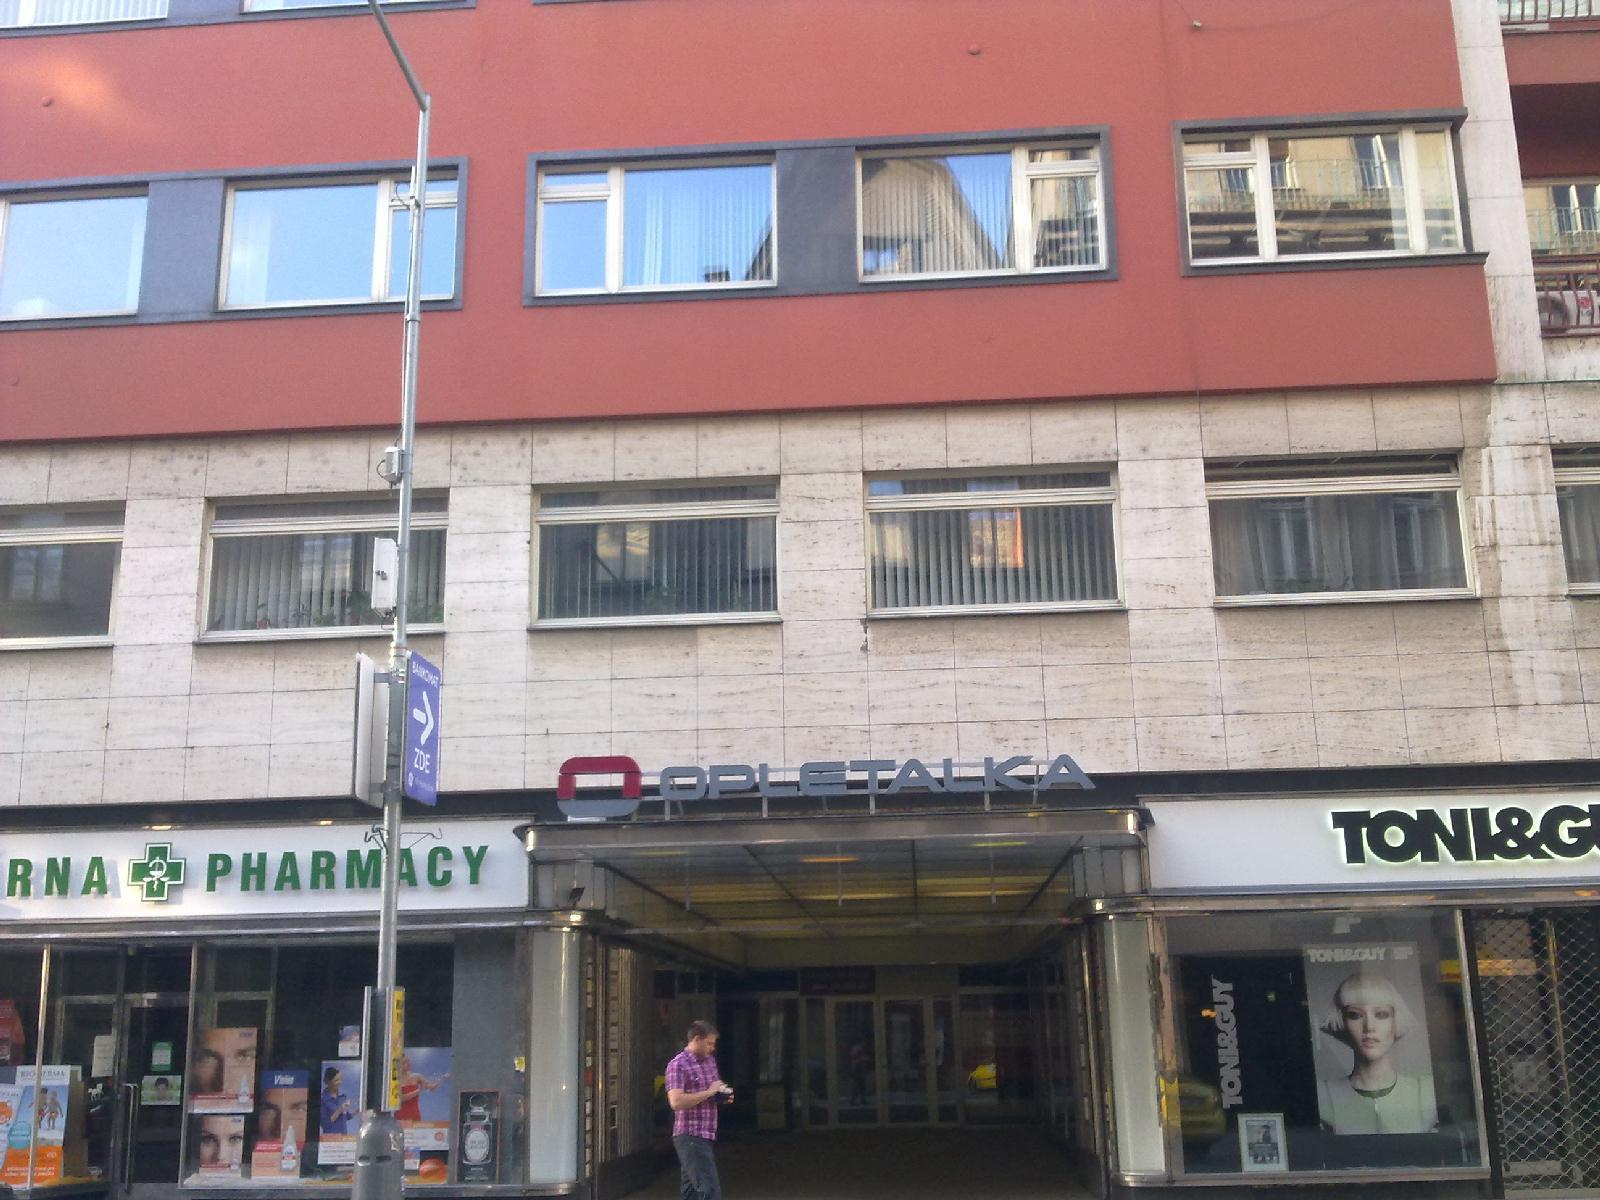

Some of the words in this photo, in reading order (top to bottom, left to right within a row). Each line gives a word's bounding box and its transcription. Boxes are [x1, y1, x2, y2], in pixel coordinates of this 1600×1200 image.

[412, 661, 439, 688] BANKOMAT
[414, 747, 430, 774] ZDE
[660, 754, 1097, 800] OPLETALKA
[7, 856, 108, 897] RNA
[206, 845, 489, 892] PHARMACY
[1306, 945, 1386, 963] TONI&GUY
[1211, 974, 1243, 1109] TONI&GUY
